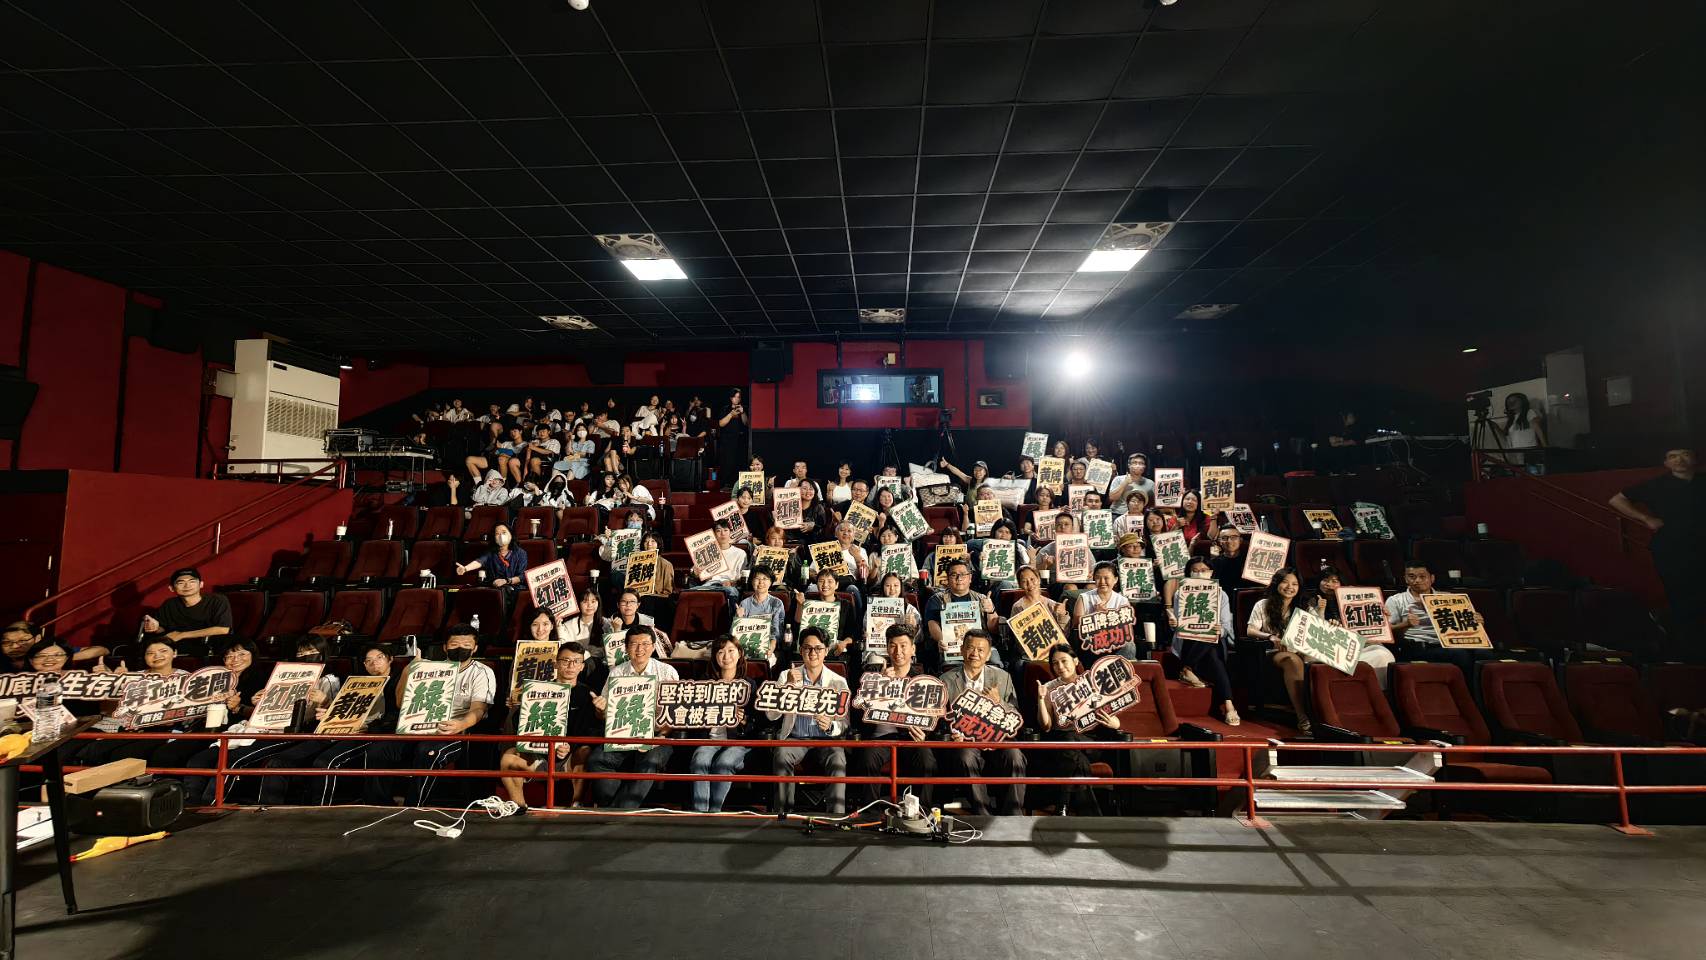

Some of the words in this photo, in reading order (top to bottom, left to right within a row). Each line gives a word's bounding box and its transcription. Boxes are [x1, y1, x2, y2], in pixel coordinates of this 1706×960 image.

[616, 538, 636, 558] 綠
[536, 579, 570, 608] 紅牌
[1081, 607, 1133, 634] 品牌急救
[1183, 592, 1215, 623] 綠牌
[1345, 603, 1384, 628] 紅牌
[1433, 607, 1479, 633] 黃牌
[1093, 624, 1131, 649] 成功!
[0, 675, 59, 696] 底的
[62, 673, 150, 697] 生存
[660, 683, 747, 704] 堅持到底的
[406, 680, 448, 722] 綠牌
[759, 684, 849, 714] 生存優先!
[957, 691, 1020, 732] 品牌急救
[524, 701, 562, 736] 綠牌
[613, 694, 651, 736] 綠牌
[658, 705, 736, 724] 人會被看見
[955, 713, 1004, 741] 成功!
